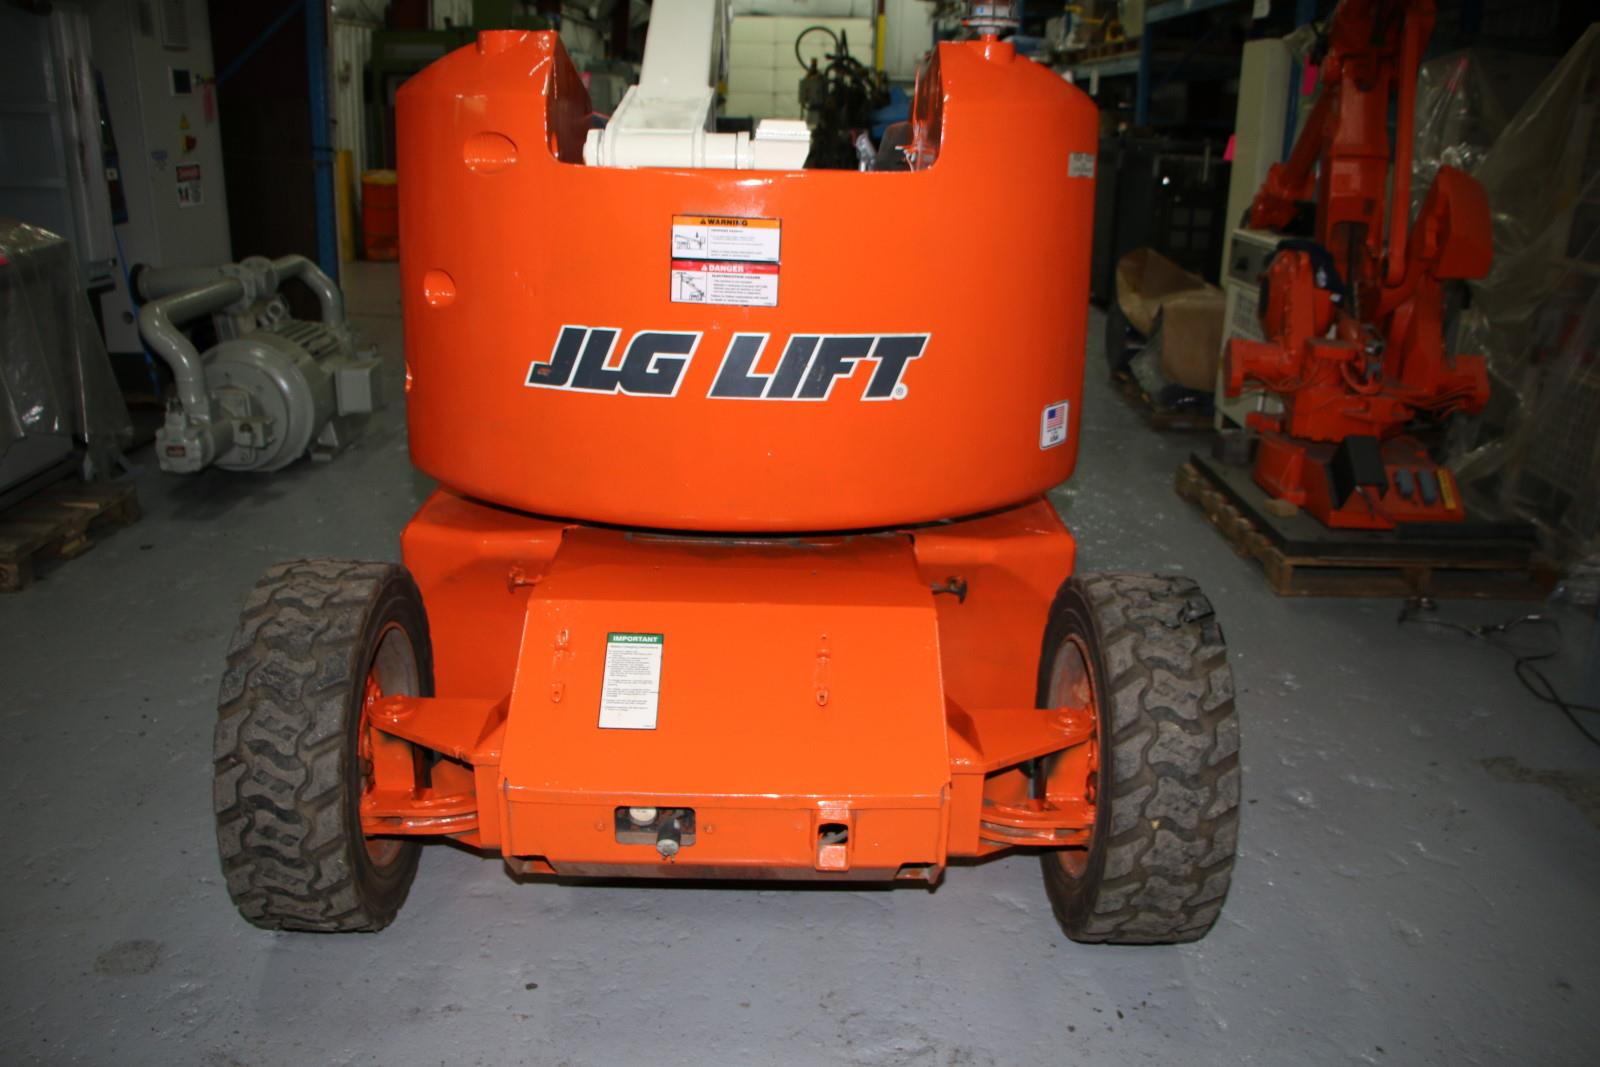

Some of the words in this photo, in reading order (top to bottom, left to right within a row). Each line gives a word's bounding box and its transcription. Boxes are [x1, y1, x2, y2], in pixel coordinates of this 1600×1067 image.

[708, 264, 745, 272] DANGER
[524, 324, 703, 398] JLG
[706, 332, 931, 401] LIFT
